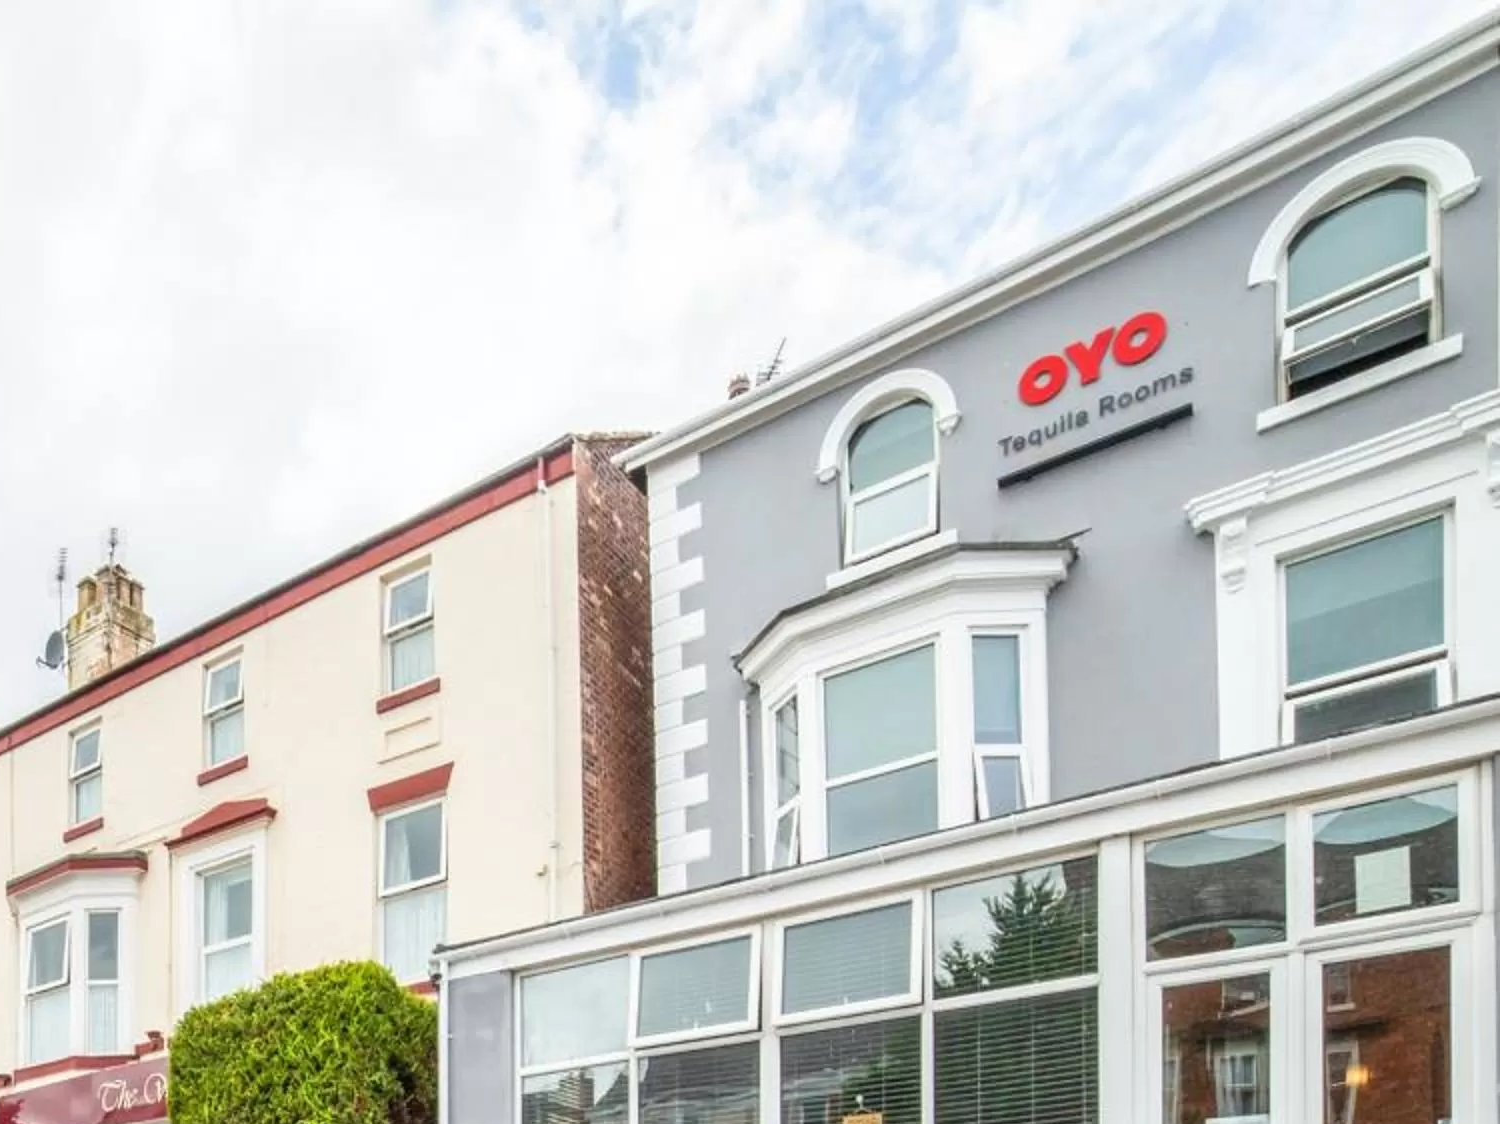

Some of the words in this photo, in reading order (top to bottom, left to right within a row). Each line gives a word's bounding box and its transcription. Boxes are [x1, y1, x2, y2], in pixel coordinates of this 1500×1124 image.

[1018, 312, 1167, 406] OYO
[998, 409, 1089, 456] Tequila
[1099, 367, 1194, 417] Rooms
